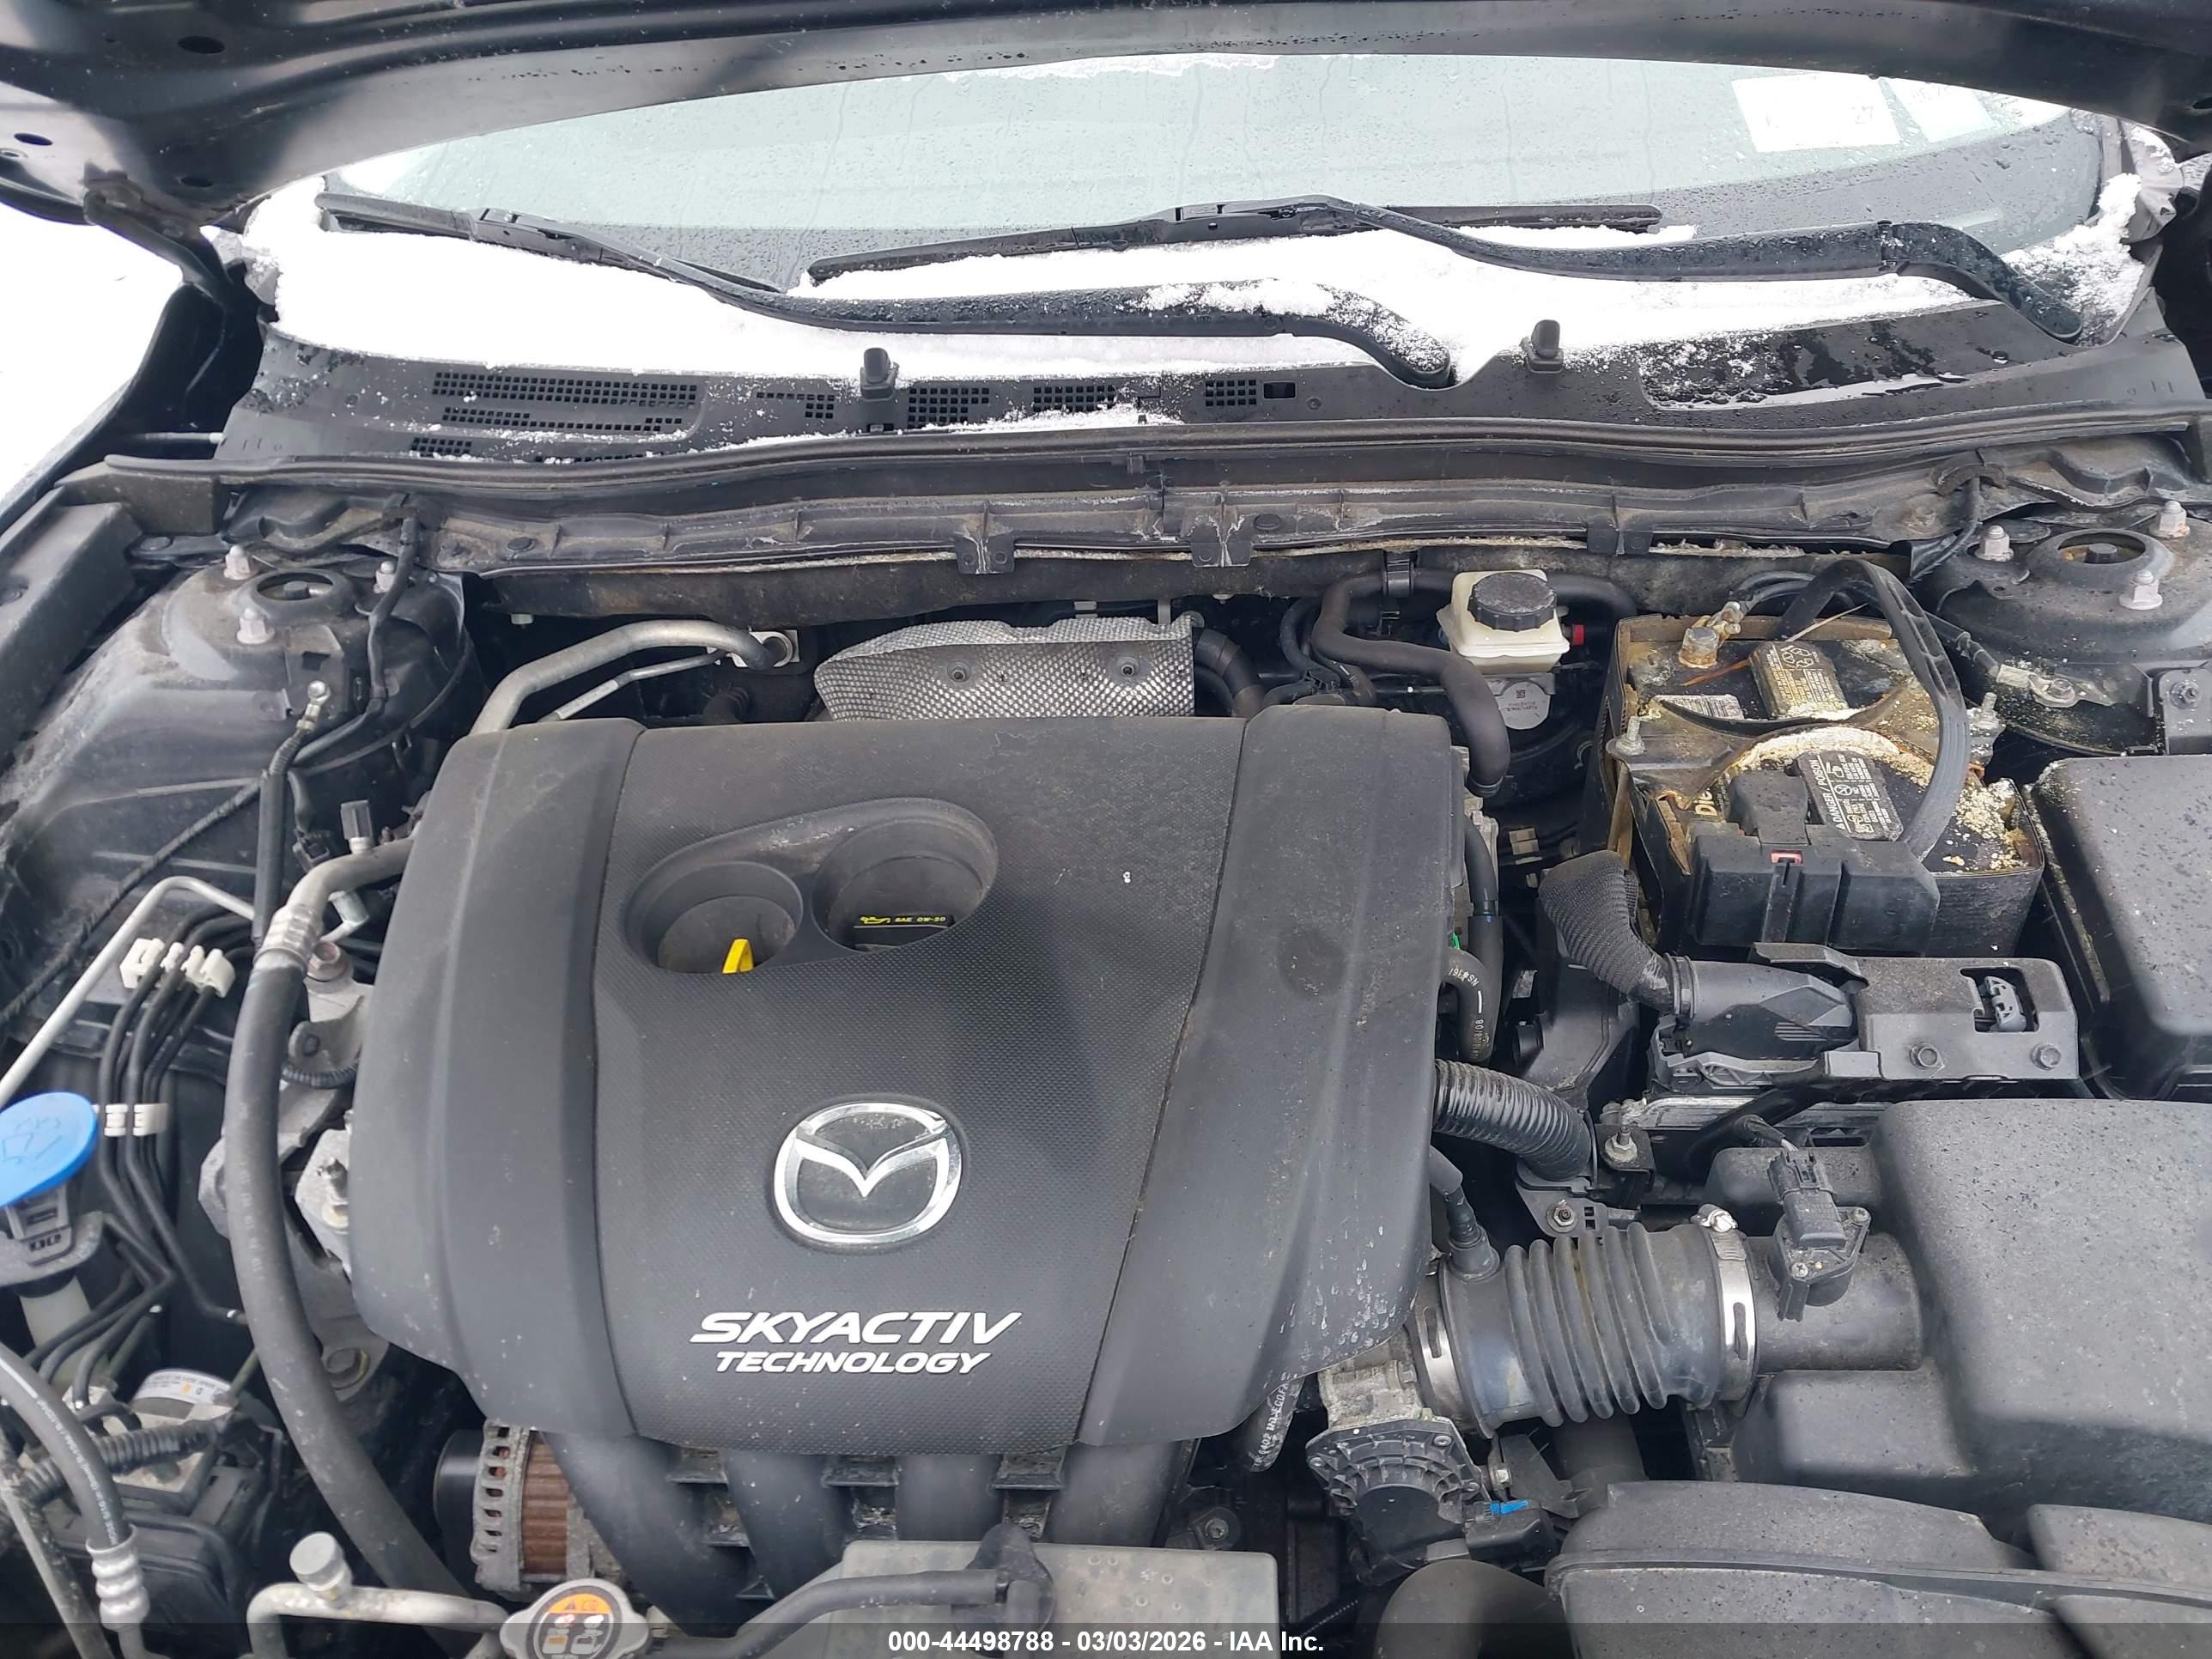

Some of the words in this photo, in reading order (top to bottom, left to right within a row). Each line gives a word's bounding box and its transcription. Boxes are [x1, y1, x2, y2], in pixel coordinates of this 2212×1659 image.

[1808, 759, 1828, 786] POISON
[1821, 793, 1842, 823] DANGER
[689, 1311, 1023, 1344] SKYACTIV
[716, 1351, 992, 1374] TECHNOLOGY
